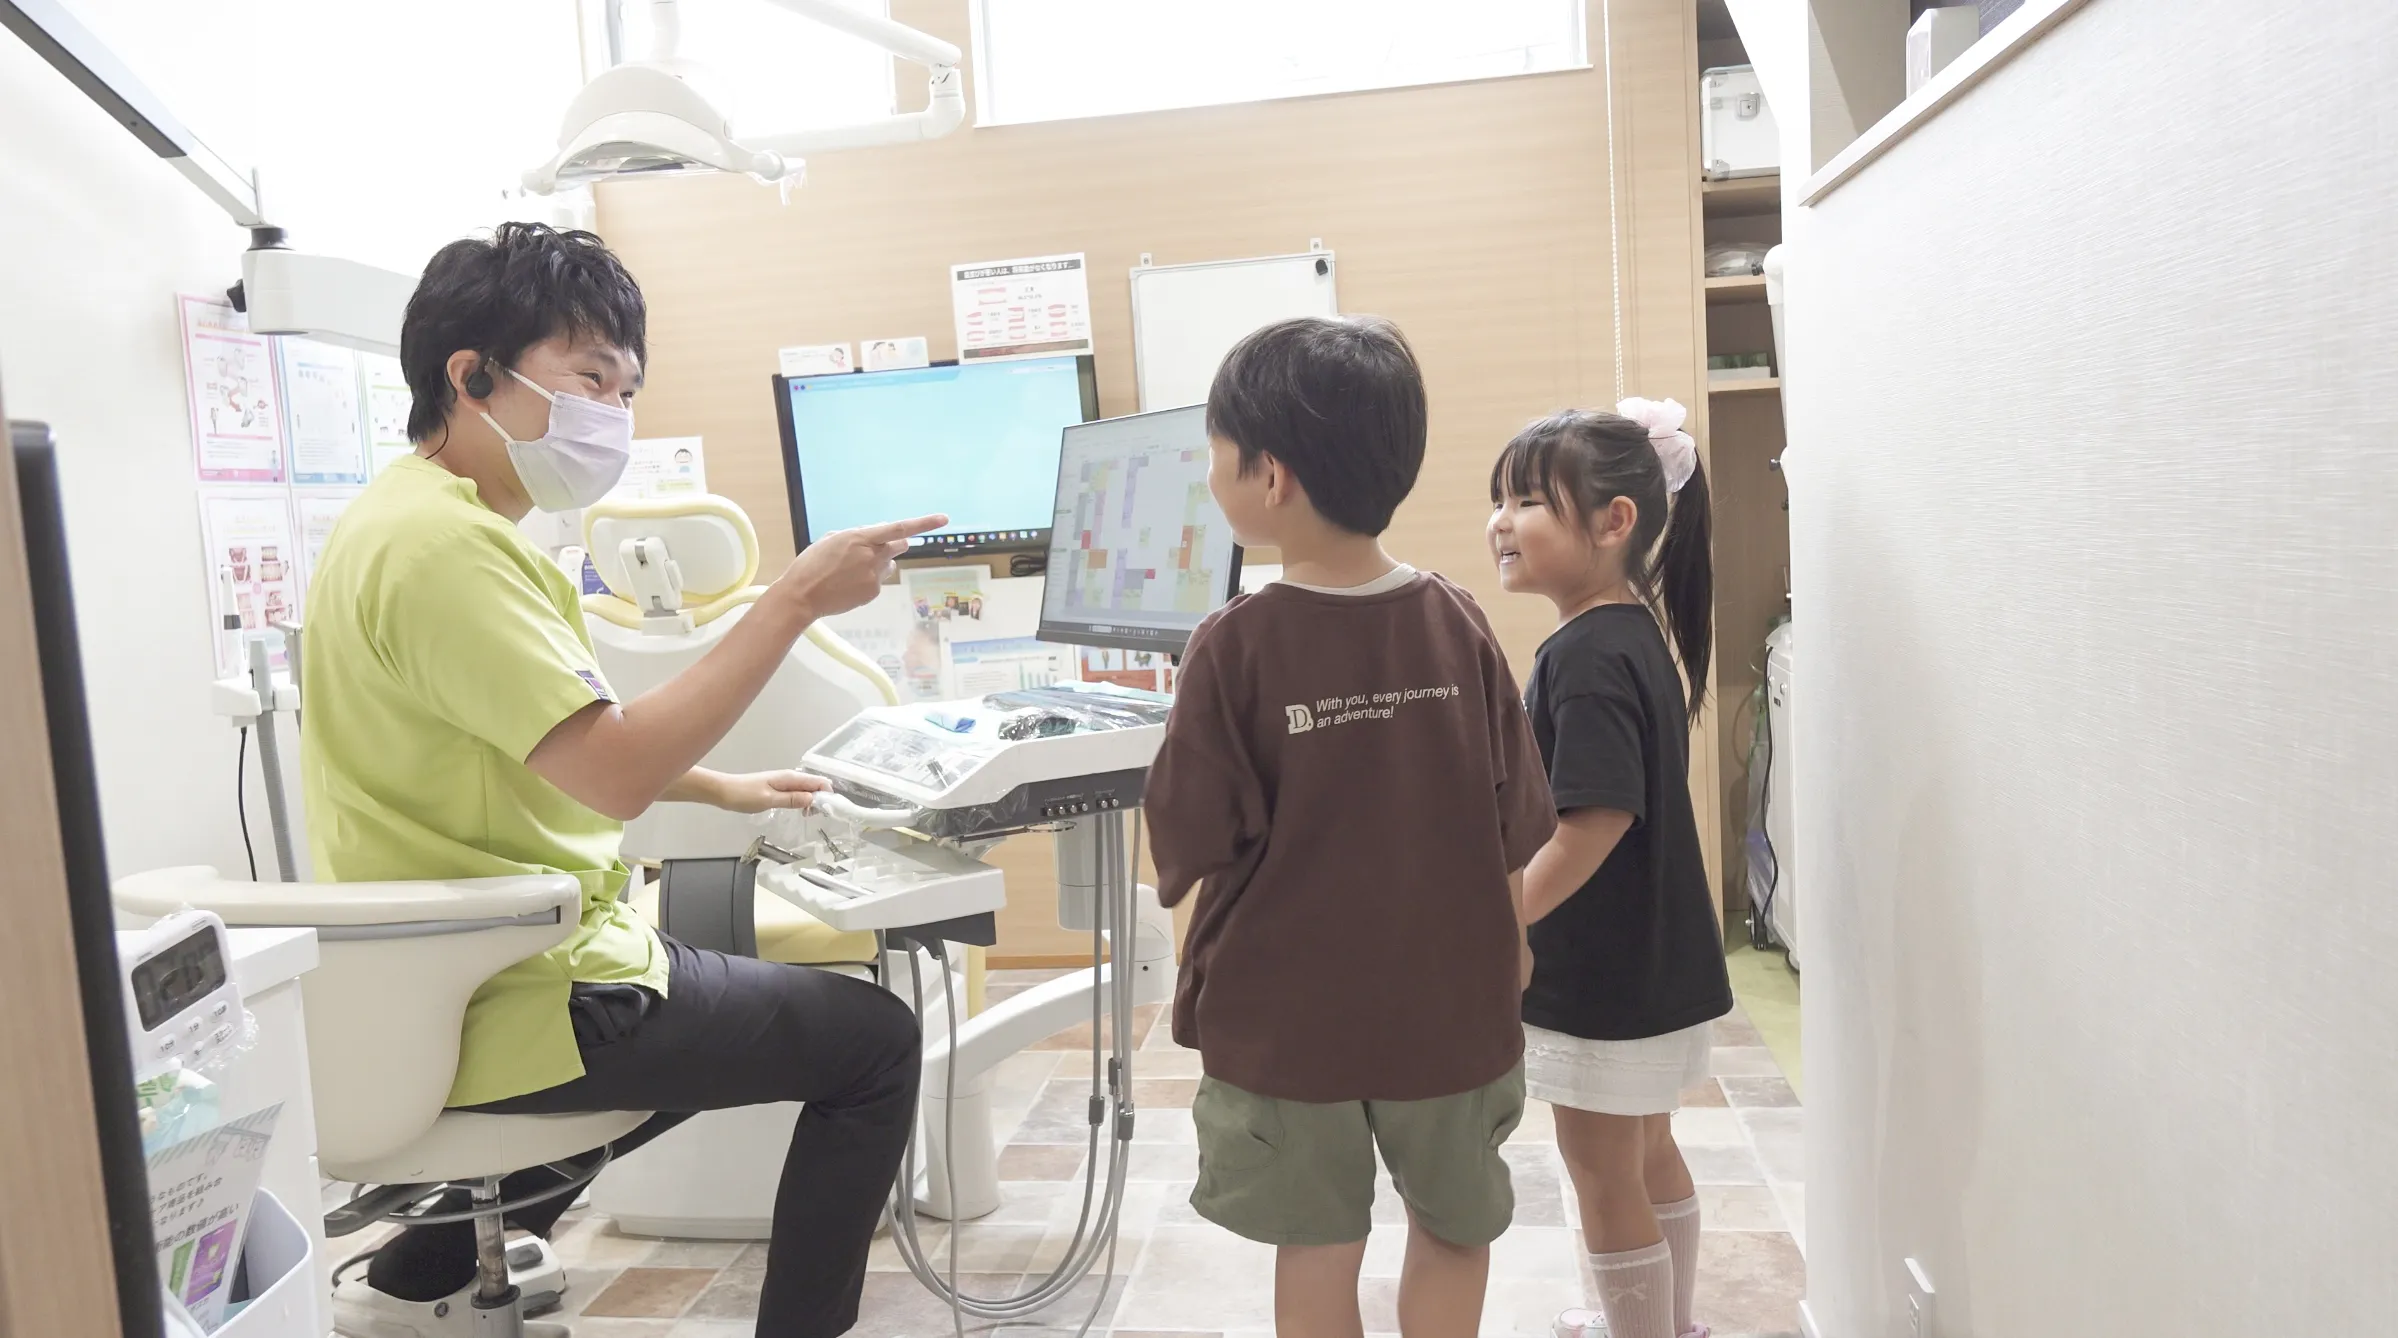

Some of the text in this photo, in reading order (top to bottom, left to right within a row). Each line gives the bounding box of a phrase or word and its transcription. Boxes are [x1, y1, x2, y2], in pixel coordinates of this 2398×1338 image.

[1316, 684, 1459, 713] With you, every journey is
[1316, 706, 1395, 729] an adventure!
